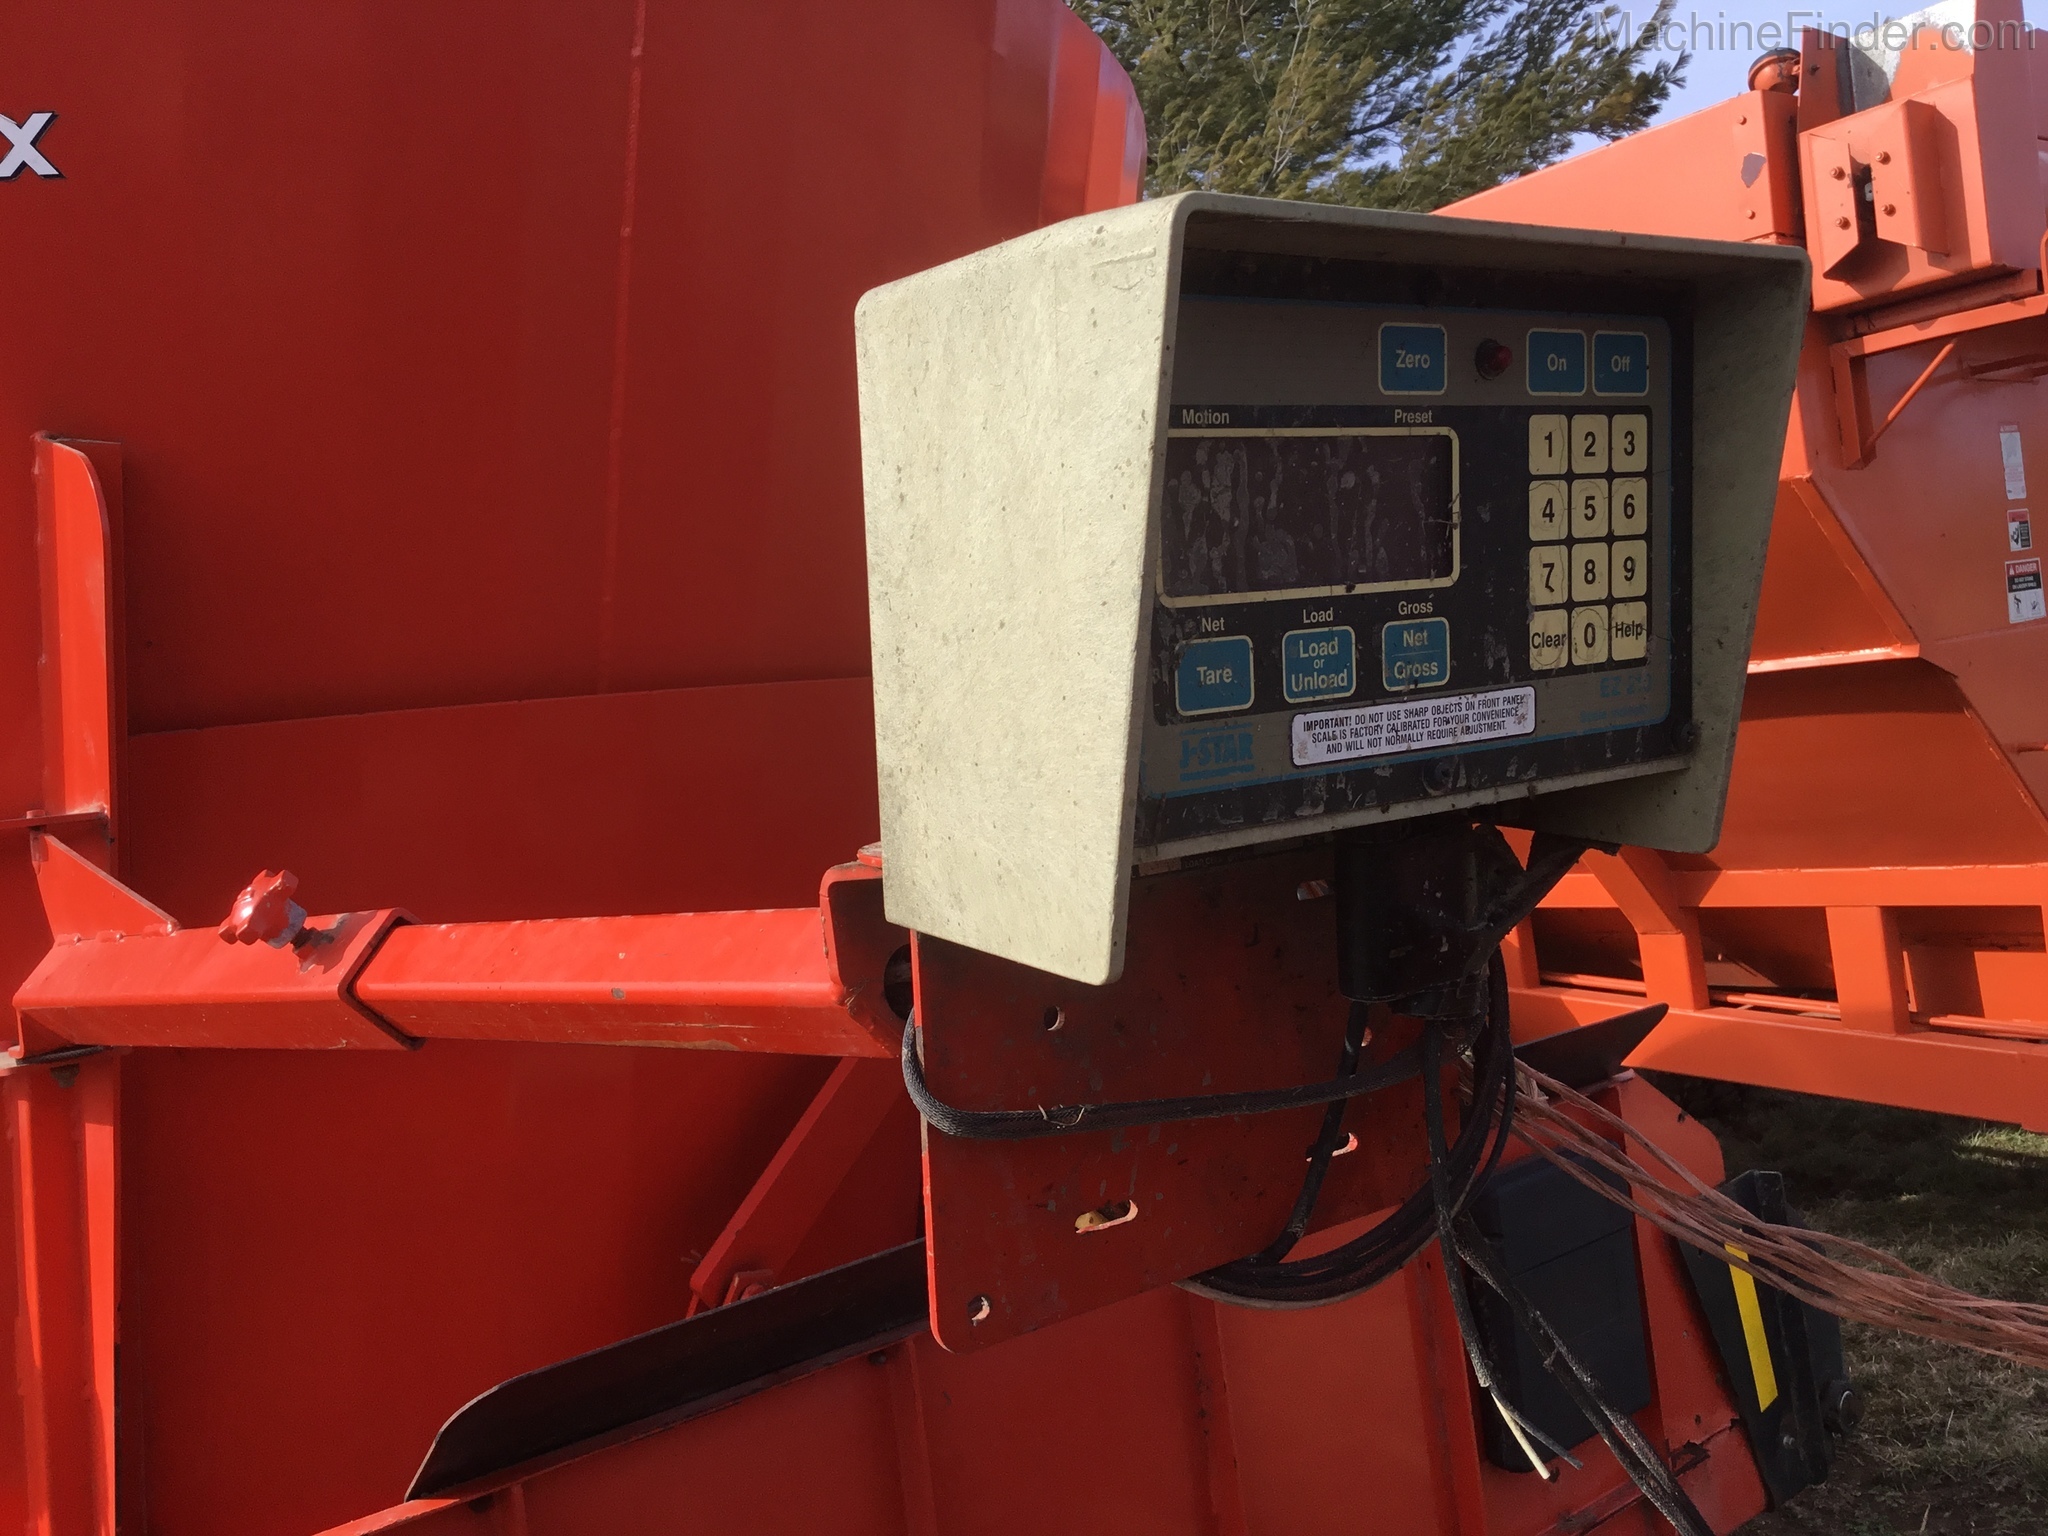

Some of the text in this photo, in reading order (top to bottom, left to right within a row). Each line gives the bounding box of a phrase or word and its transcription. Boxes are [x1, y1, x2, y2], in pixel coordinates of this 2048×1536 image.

[1395, 349, 1431, 370] Zero
[1547, 353, 1567, 372] On
[1611, 355, 1631, 373] Off
[1182, 408, 1230, 425] Motion
[1394, 408, 1433, 425] Preset
[1544, 430, 1636, 458] 1 2 3
[1542, 493, 1636, 523] 4 5 6
[1542, 556, 1636, 593] 7 8 9
[1303, 607, 1334, 624] Load
[1398, 600, 1434, 616] Gross
[1202, 617, 1226, 633] Net
[1531, 620, 1643, 649] Clear 0 Help
[1299, 637, 1339, 659] Load
[1403, 629, 1429, 648] Net
[1313, 658, 1325, 670] or
[1394, 661, 1439, 680] Gross
[1196, 665, 1233, 686] Tare
[1291, 668, 1348, 693] Unload
[1304, 716, 1352, 732] IMPORTANT!
[1354, 714, 1367, 726] DO
[1368, 711, 1385, 724] NOT
[1386, 709, 1402, 721] USE
[1403, 706, 1429, 720] SHARP
[1431, 701, 1463, 717] OBJECTS
[1465, 700, 1476, 712] ON
[1477, 697, 1501, 710] FRONT
[1311, 731, 1338, 744] SCALE
[1339, 729, 1348, 741] IS
[1350, 723, 1384, 739] FACTORY
[1387, 719, 1430, 733] CALIBRATED
[1433, 716, 1449, 728] FOR
[1450, 713, 1470, 726] YOUR
[1180, 733, 1254, 769] J-STAR
[1326, 741, 1343, 754] AND
[1345, 738, 1365, 751] WILL
[1367, 736, 1384, 749] NOT
[1385, 731, 1424, 746] NORMALLY
[1427, 727, 1458, 740] REQUIRE
